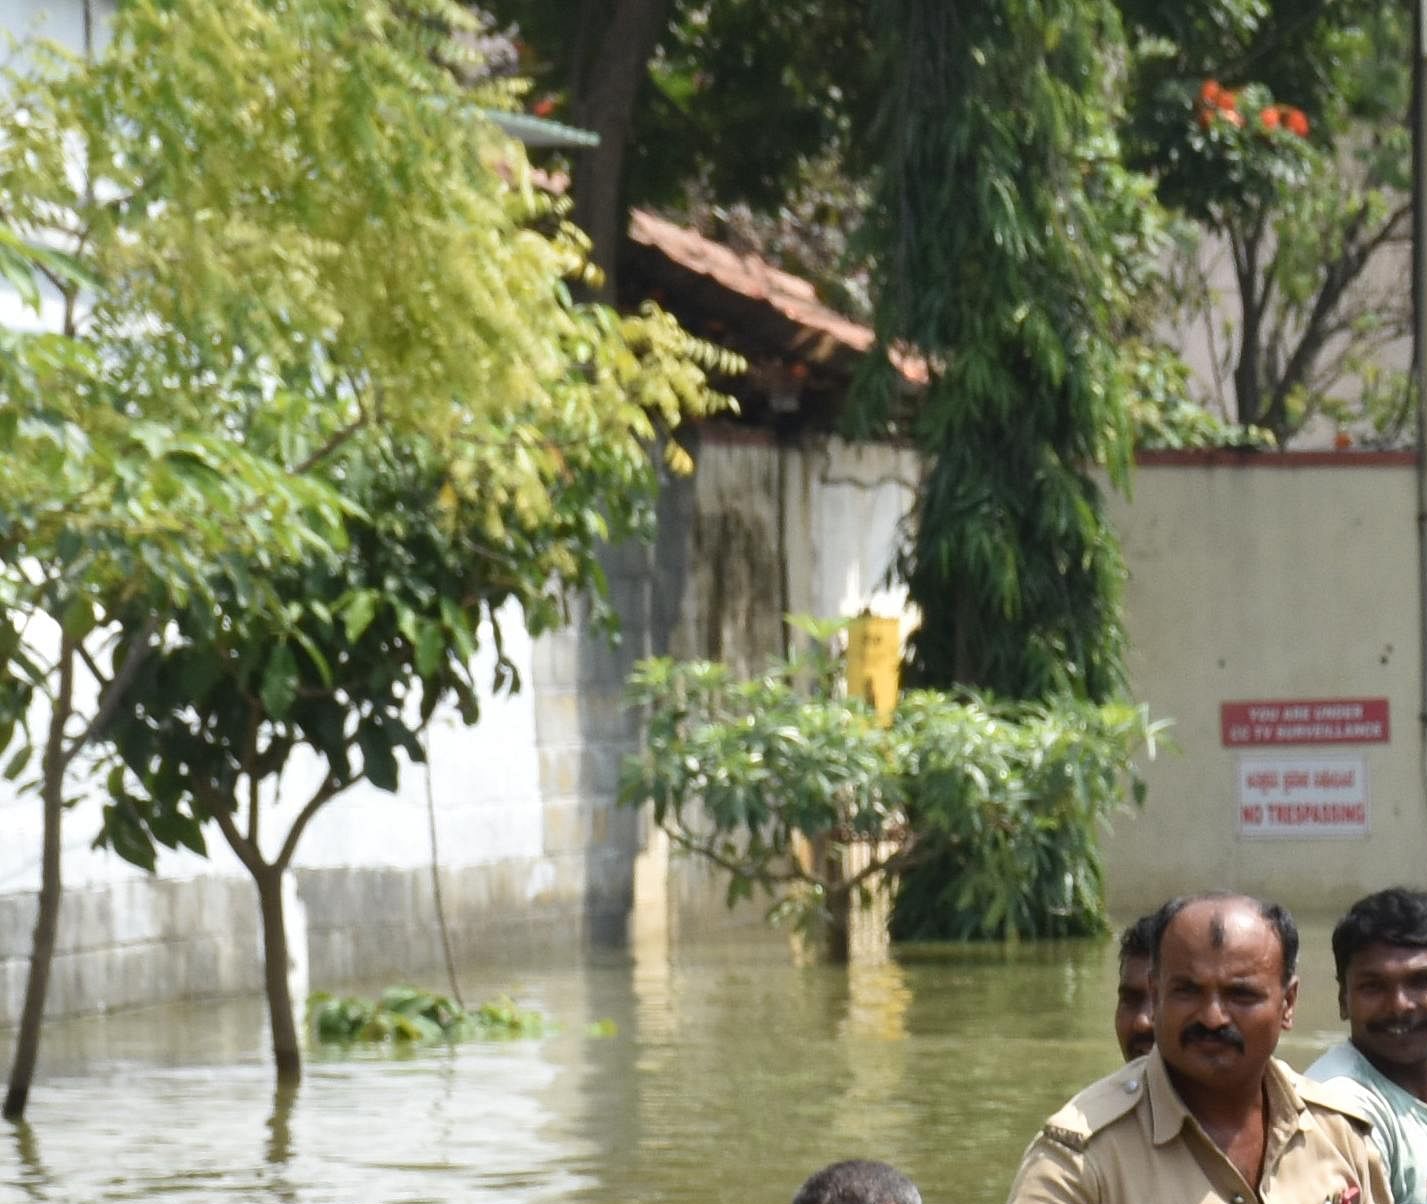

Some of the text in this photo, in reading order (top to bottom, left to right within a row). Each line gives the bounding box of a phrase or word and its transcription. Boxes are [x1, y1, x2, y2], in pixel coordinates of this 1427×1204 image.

[1248, 702, 1364, 722] YOU ARE UNDER
[1253, 724, 1273, 741] TV
[1277, 720, 1383, 738] SURVEILLANCE
[1240, 803, 1366, 825] NO TRESPASSING
